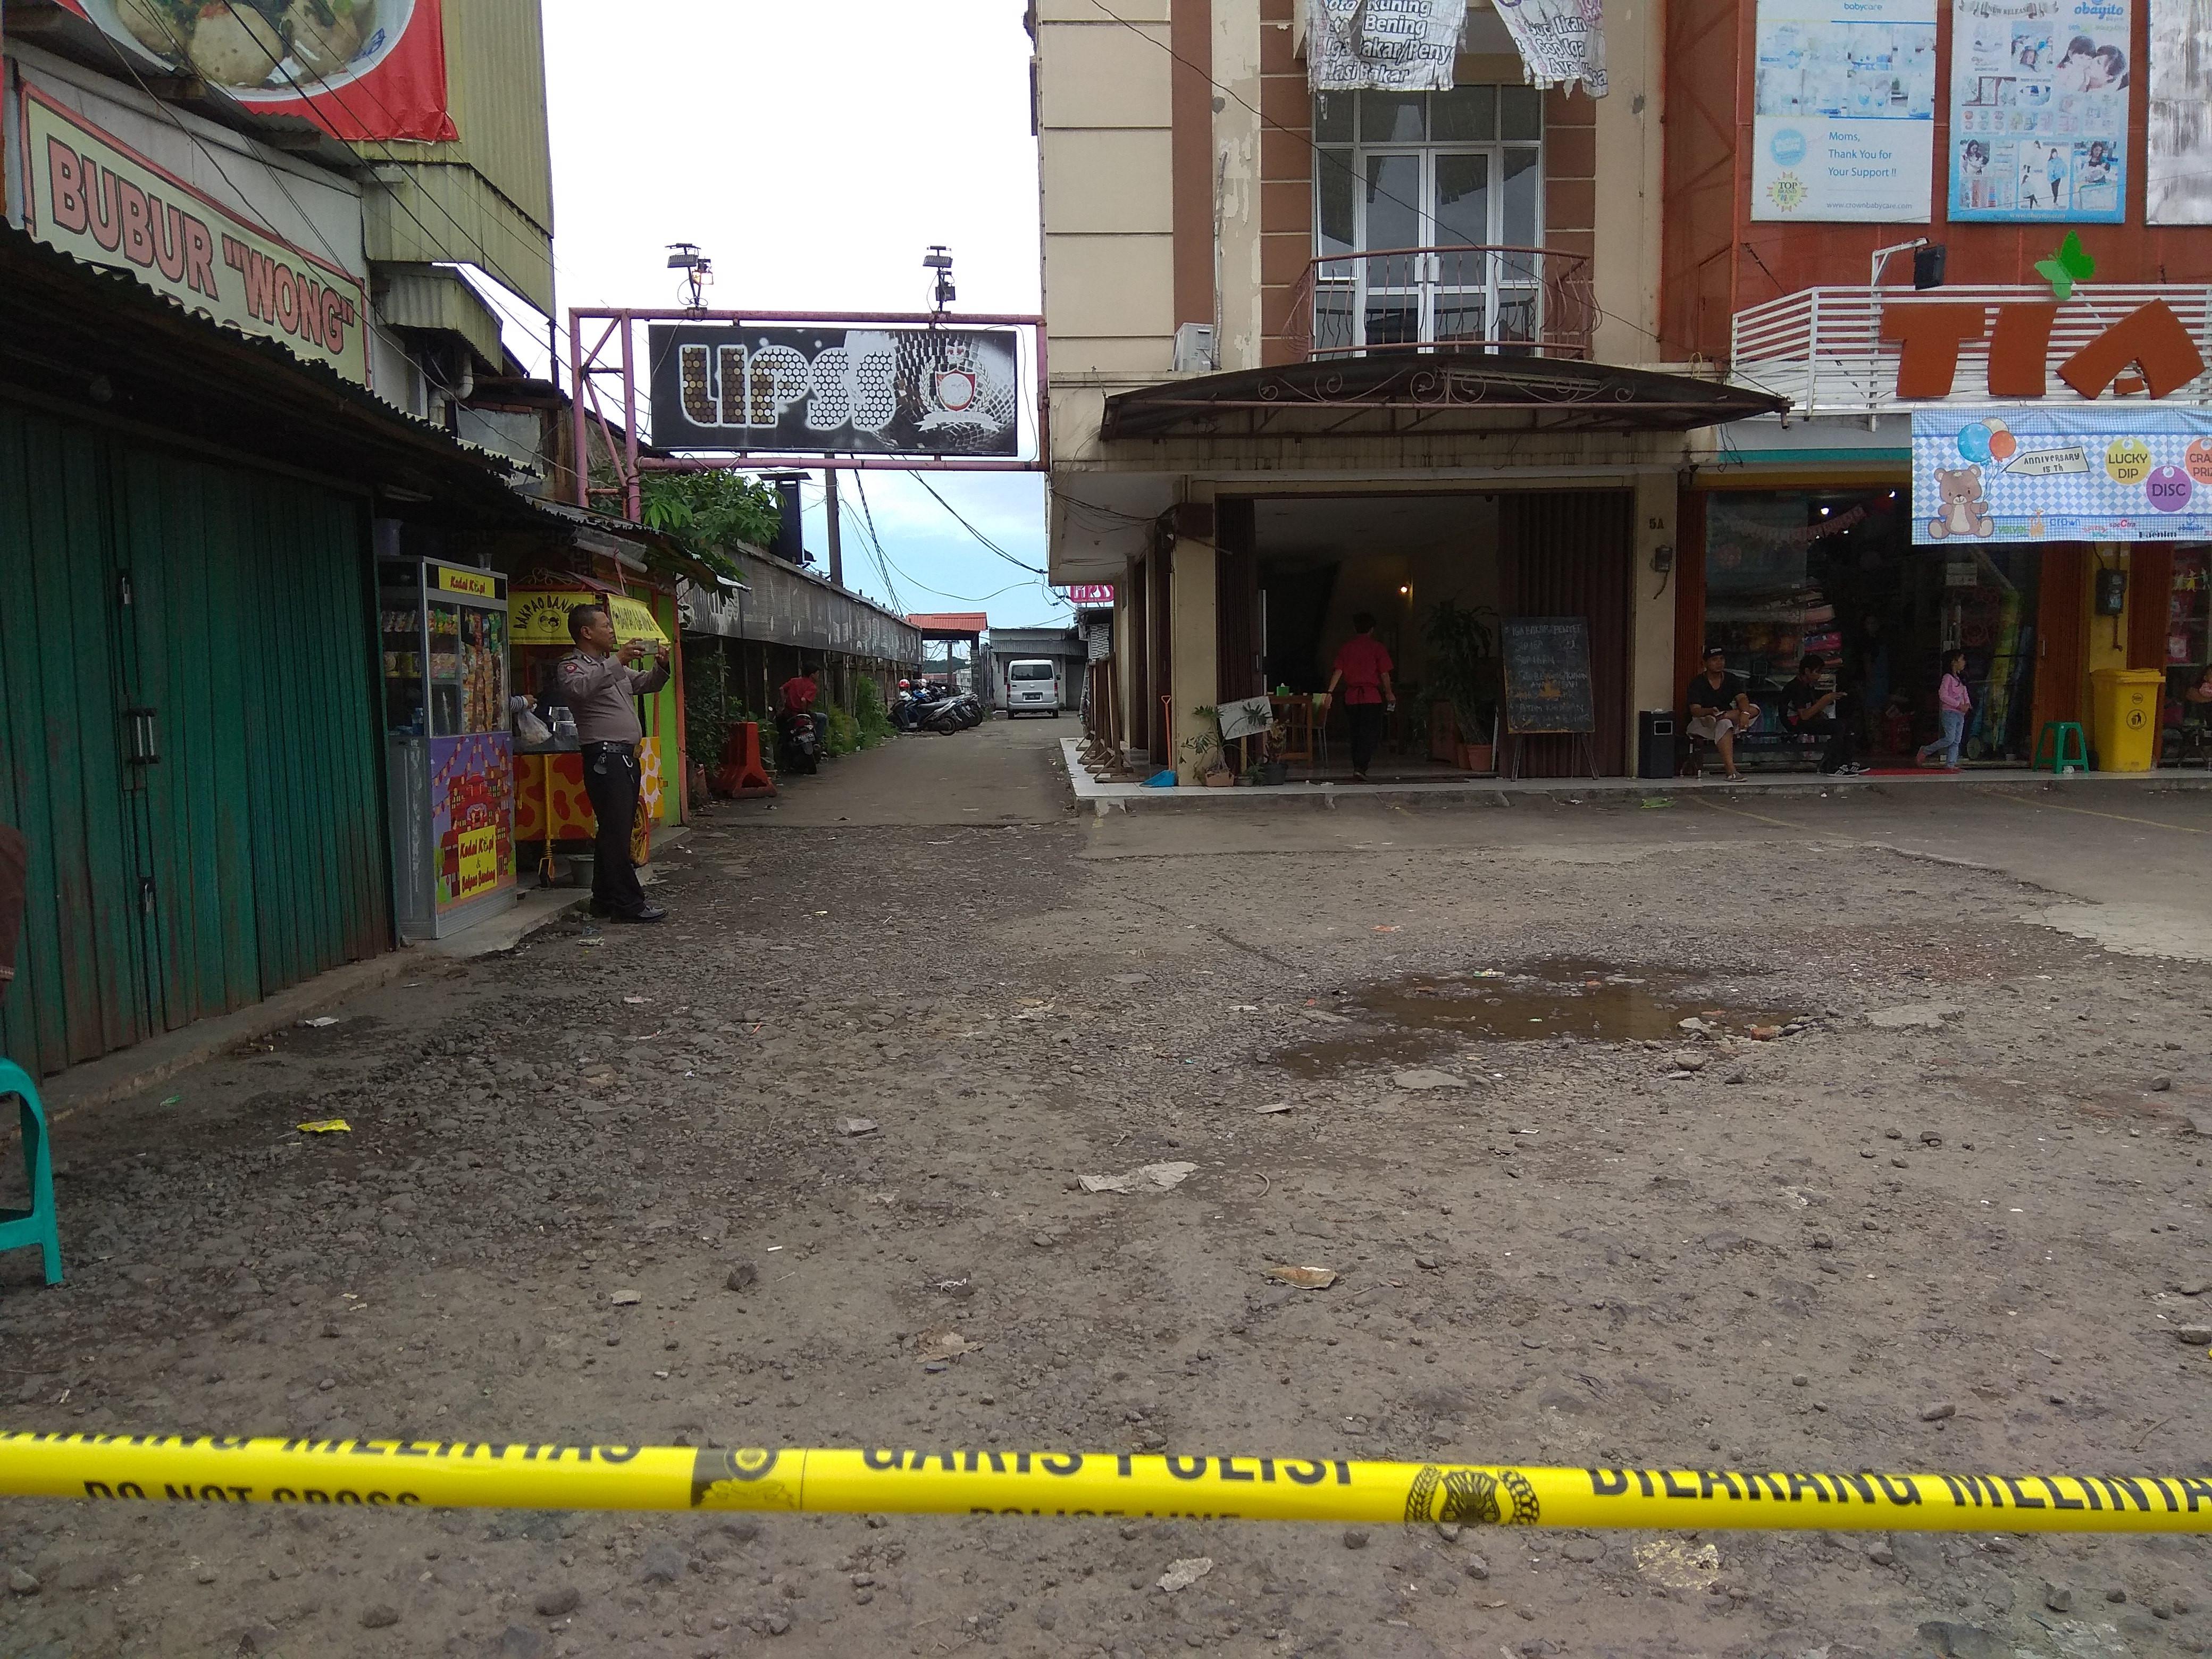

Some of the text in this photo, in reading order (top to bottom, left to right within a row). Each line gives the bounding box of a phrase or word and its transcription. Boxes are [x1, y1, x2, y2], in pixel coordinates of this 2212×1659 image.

[1844, 2, 1882, 11] babycare
[1363, 14, 1428, 39] Bening
[1554, 15, 1588, 33] Ikan
[1536, 39, 1564, 58] Sop
[1563, 38, 1586, 61] Iga
[1829, 131, 1860, 142] Moms,
[1828, 149, 1892, 158] Thank You for
[1828, 167, 1849, 177] Your
[1851, 167, 1889, 178] Support
[47, 133, 354, 355] BUBUR "WONG"
[2108, 454, 2148, 464] LUCKY
[2190, 453, 2212, 463] CRA
[2118, 468, 2139, 479] DIP
[2152, 483, 2186, 497] DISC
[1649, 518, 1664, 530] 5A
